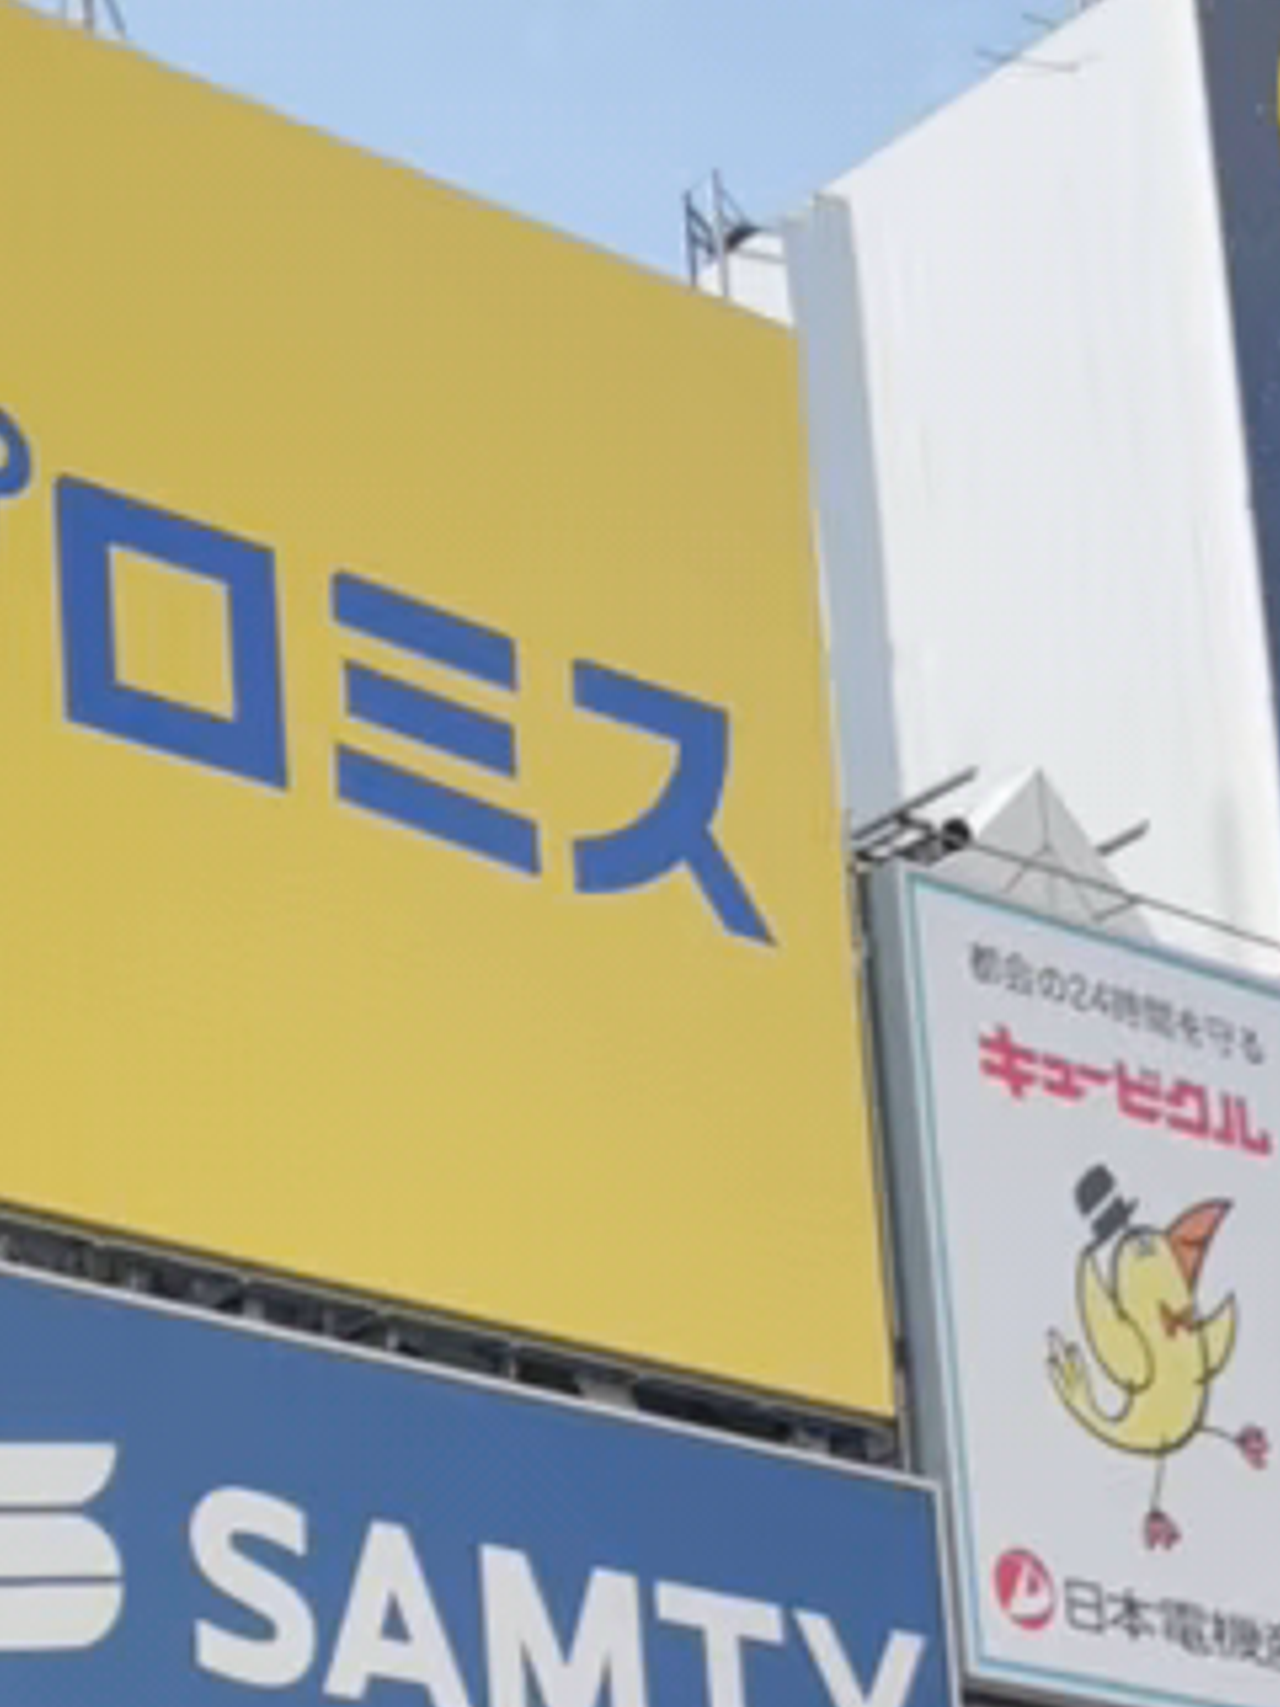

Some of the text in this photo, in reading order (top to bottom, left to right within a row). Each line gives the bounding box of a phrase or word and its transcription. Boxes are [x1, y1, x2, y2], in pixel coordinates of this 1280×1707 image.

[977, 1021, 1274, 1158] キュービクル
